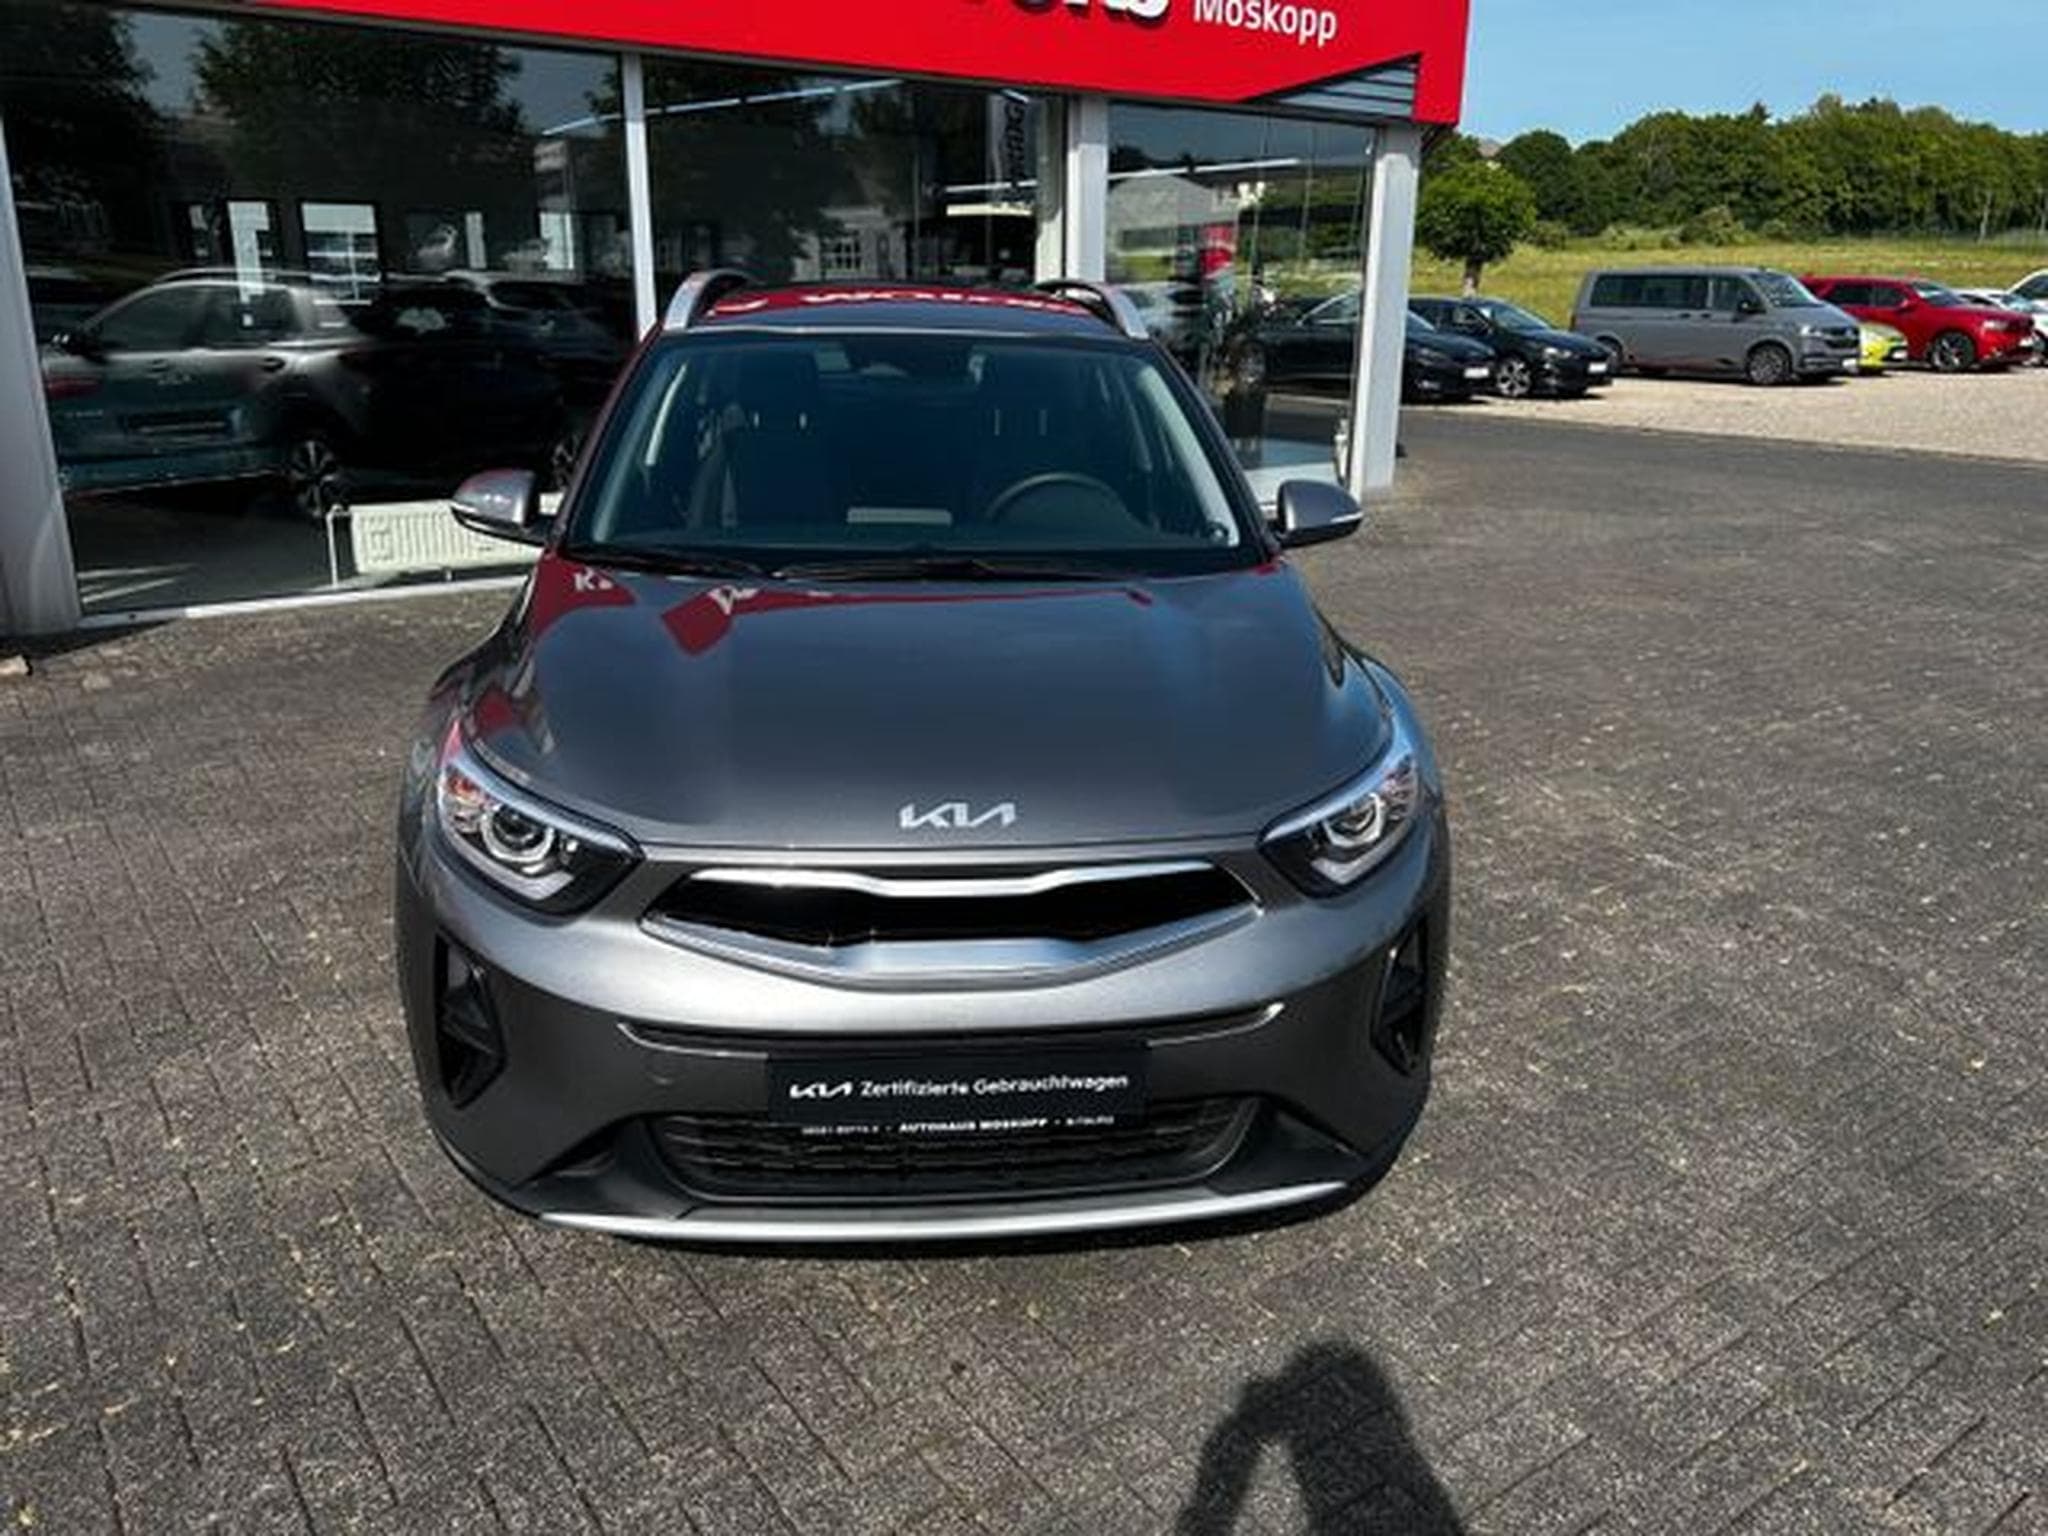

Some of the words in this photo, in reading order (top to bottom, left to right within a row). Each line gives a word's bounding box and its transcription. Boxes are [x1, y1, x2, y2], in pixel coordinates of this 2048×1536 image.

[1193, 0, 1337, 47] Moskopp
[900, 802, 1016, 828] KIA
[789, 1081, 853, 1099] KIA
[860, 1078, 969, 1098] Zertifizierte
[972, 1074, 1129, 1096] Gebrauchtwagen
